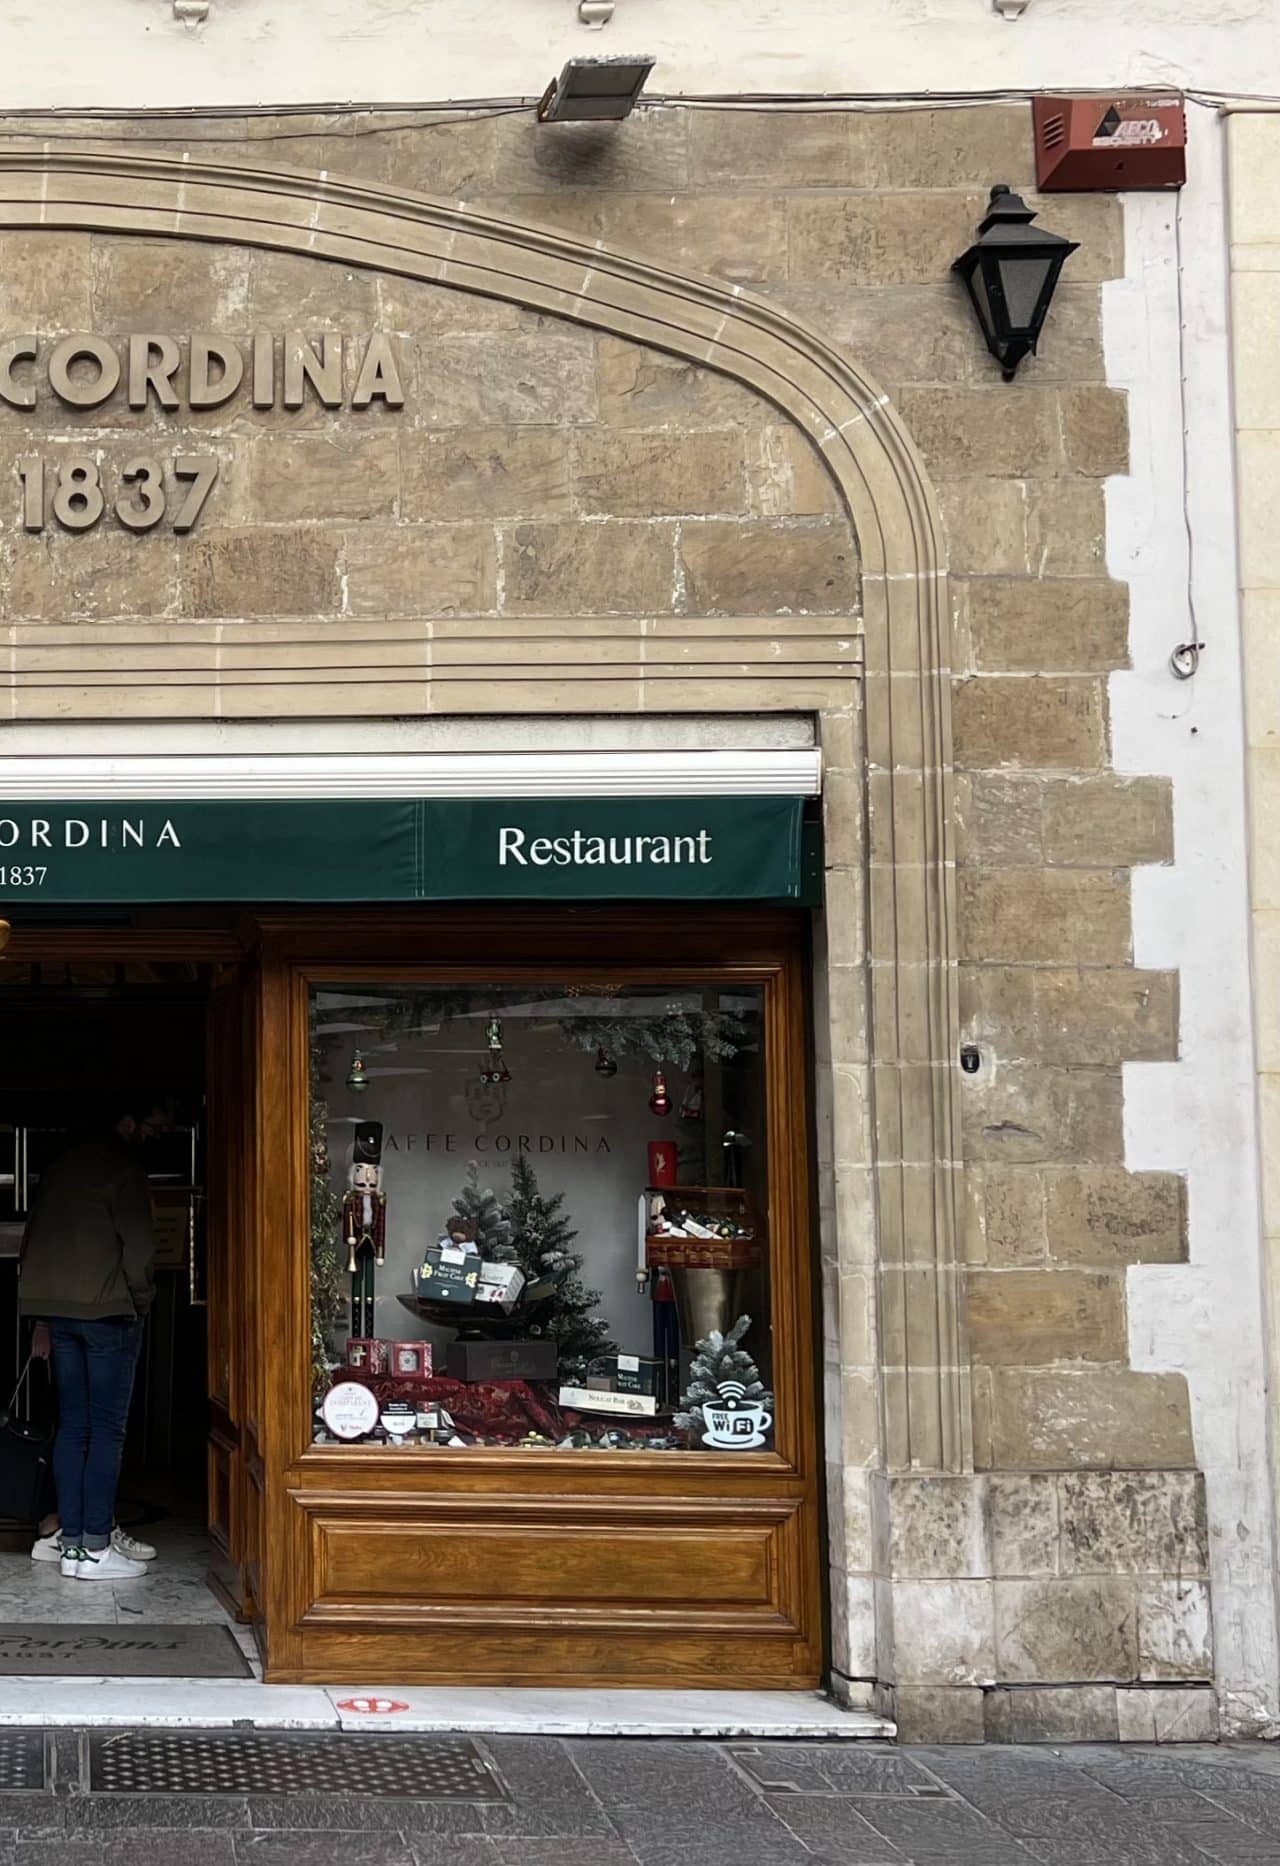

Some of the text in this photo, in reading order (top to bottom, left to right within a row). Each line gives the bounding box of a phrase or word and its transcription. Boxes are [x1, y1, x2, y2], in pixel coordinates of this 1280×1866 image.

[18, 455, 220, 532] 1837
[498, 827, 713, 865] Restaurant
[384, 1134, 612, 1152] AFFE CORDINA
